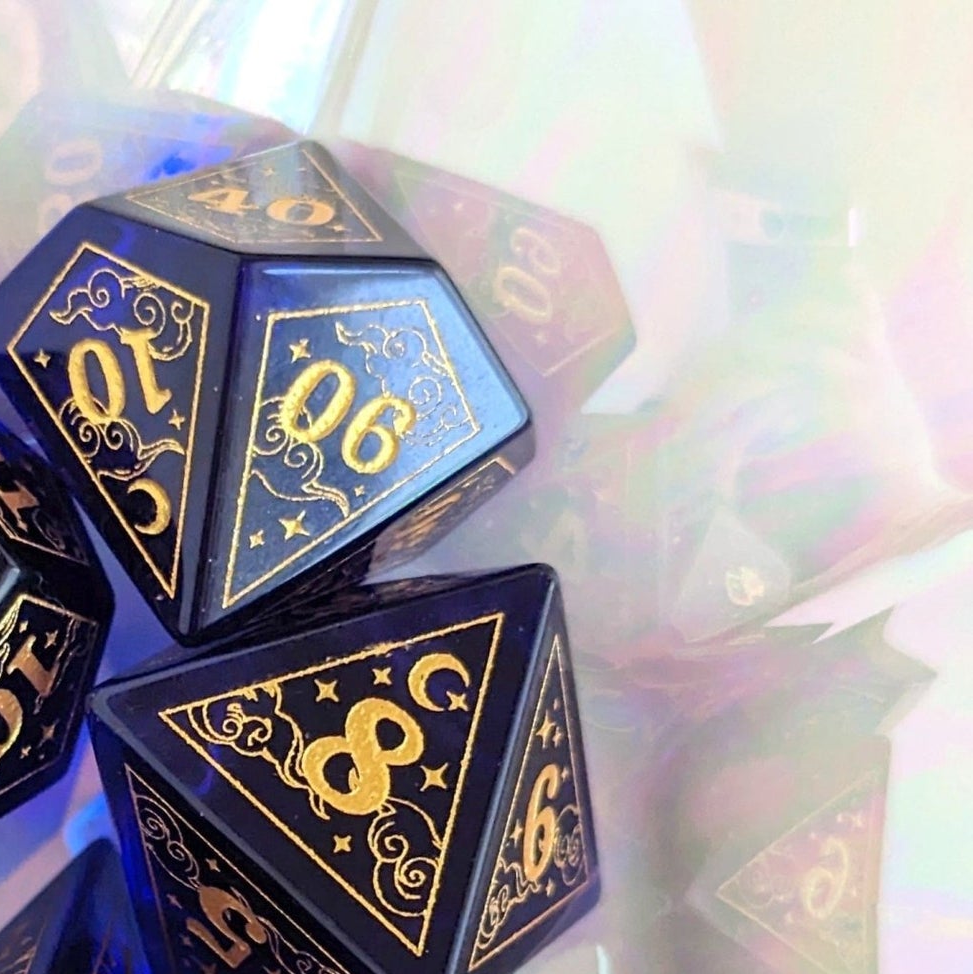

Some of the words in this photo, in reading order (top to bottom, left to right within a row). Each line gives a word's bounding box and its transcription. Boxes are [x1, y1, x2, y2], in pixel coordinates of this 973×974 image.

[187, 188, 335, 226] 40
[67, 329, 172, 424] 10
[302, 698, 424, 815] 8
[522, 764, 557, 879] 6
[186, 887, 266, 968] 5
